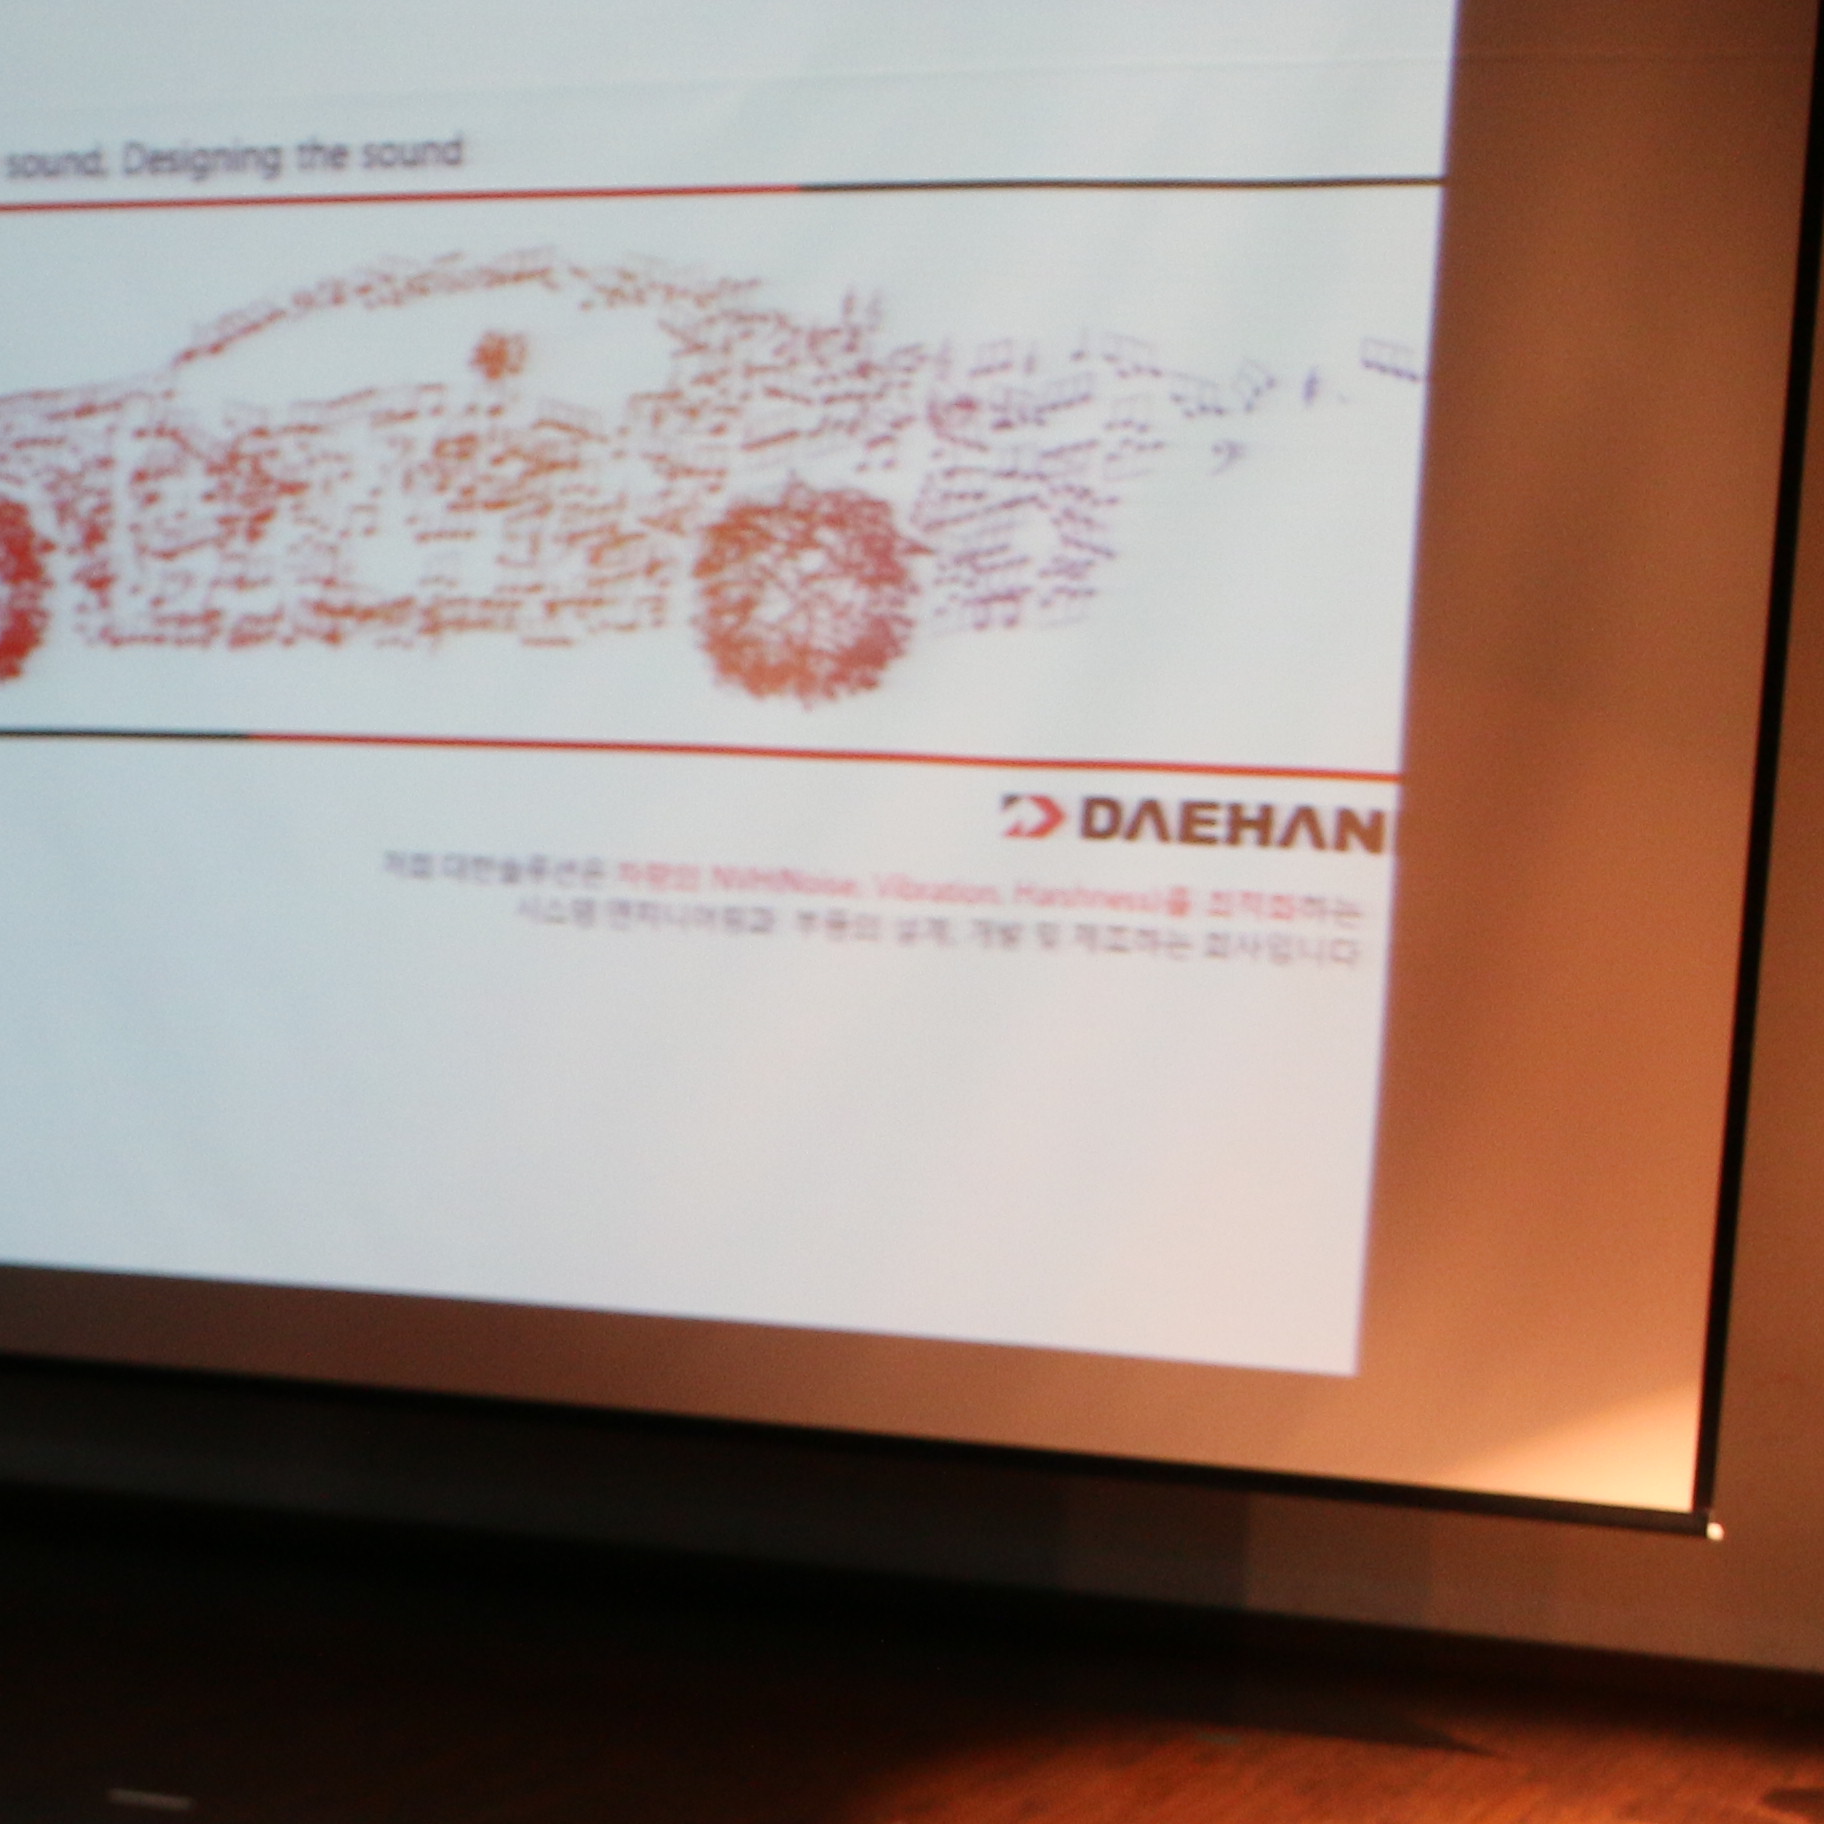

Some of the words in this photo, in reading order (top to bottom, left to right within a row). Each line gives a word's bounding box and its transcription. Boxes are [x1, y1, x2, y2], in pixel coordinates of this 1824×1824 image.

[122, 139, 281, 182] Designing
[297, 134, 349, 171] the
[362, 129, 463, 169] sound
[1081, 795, 1388, 855] DAEHAN
